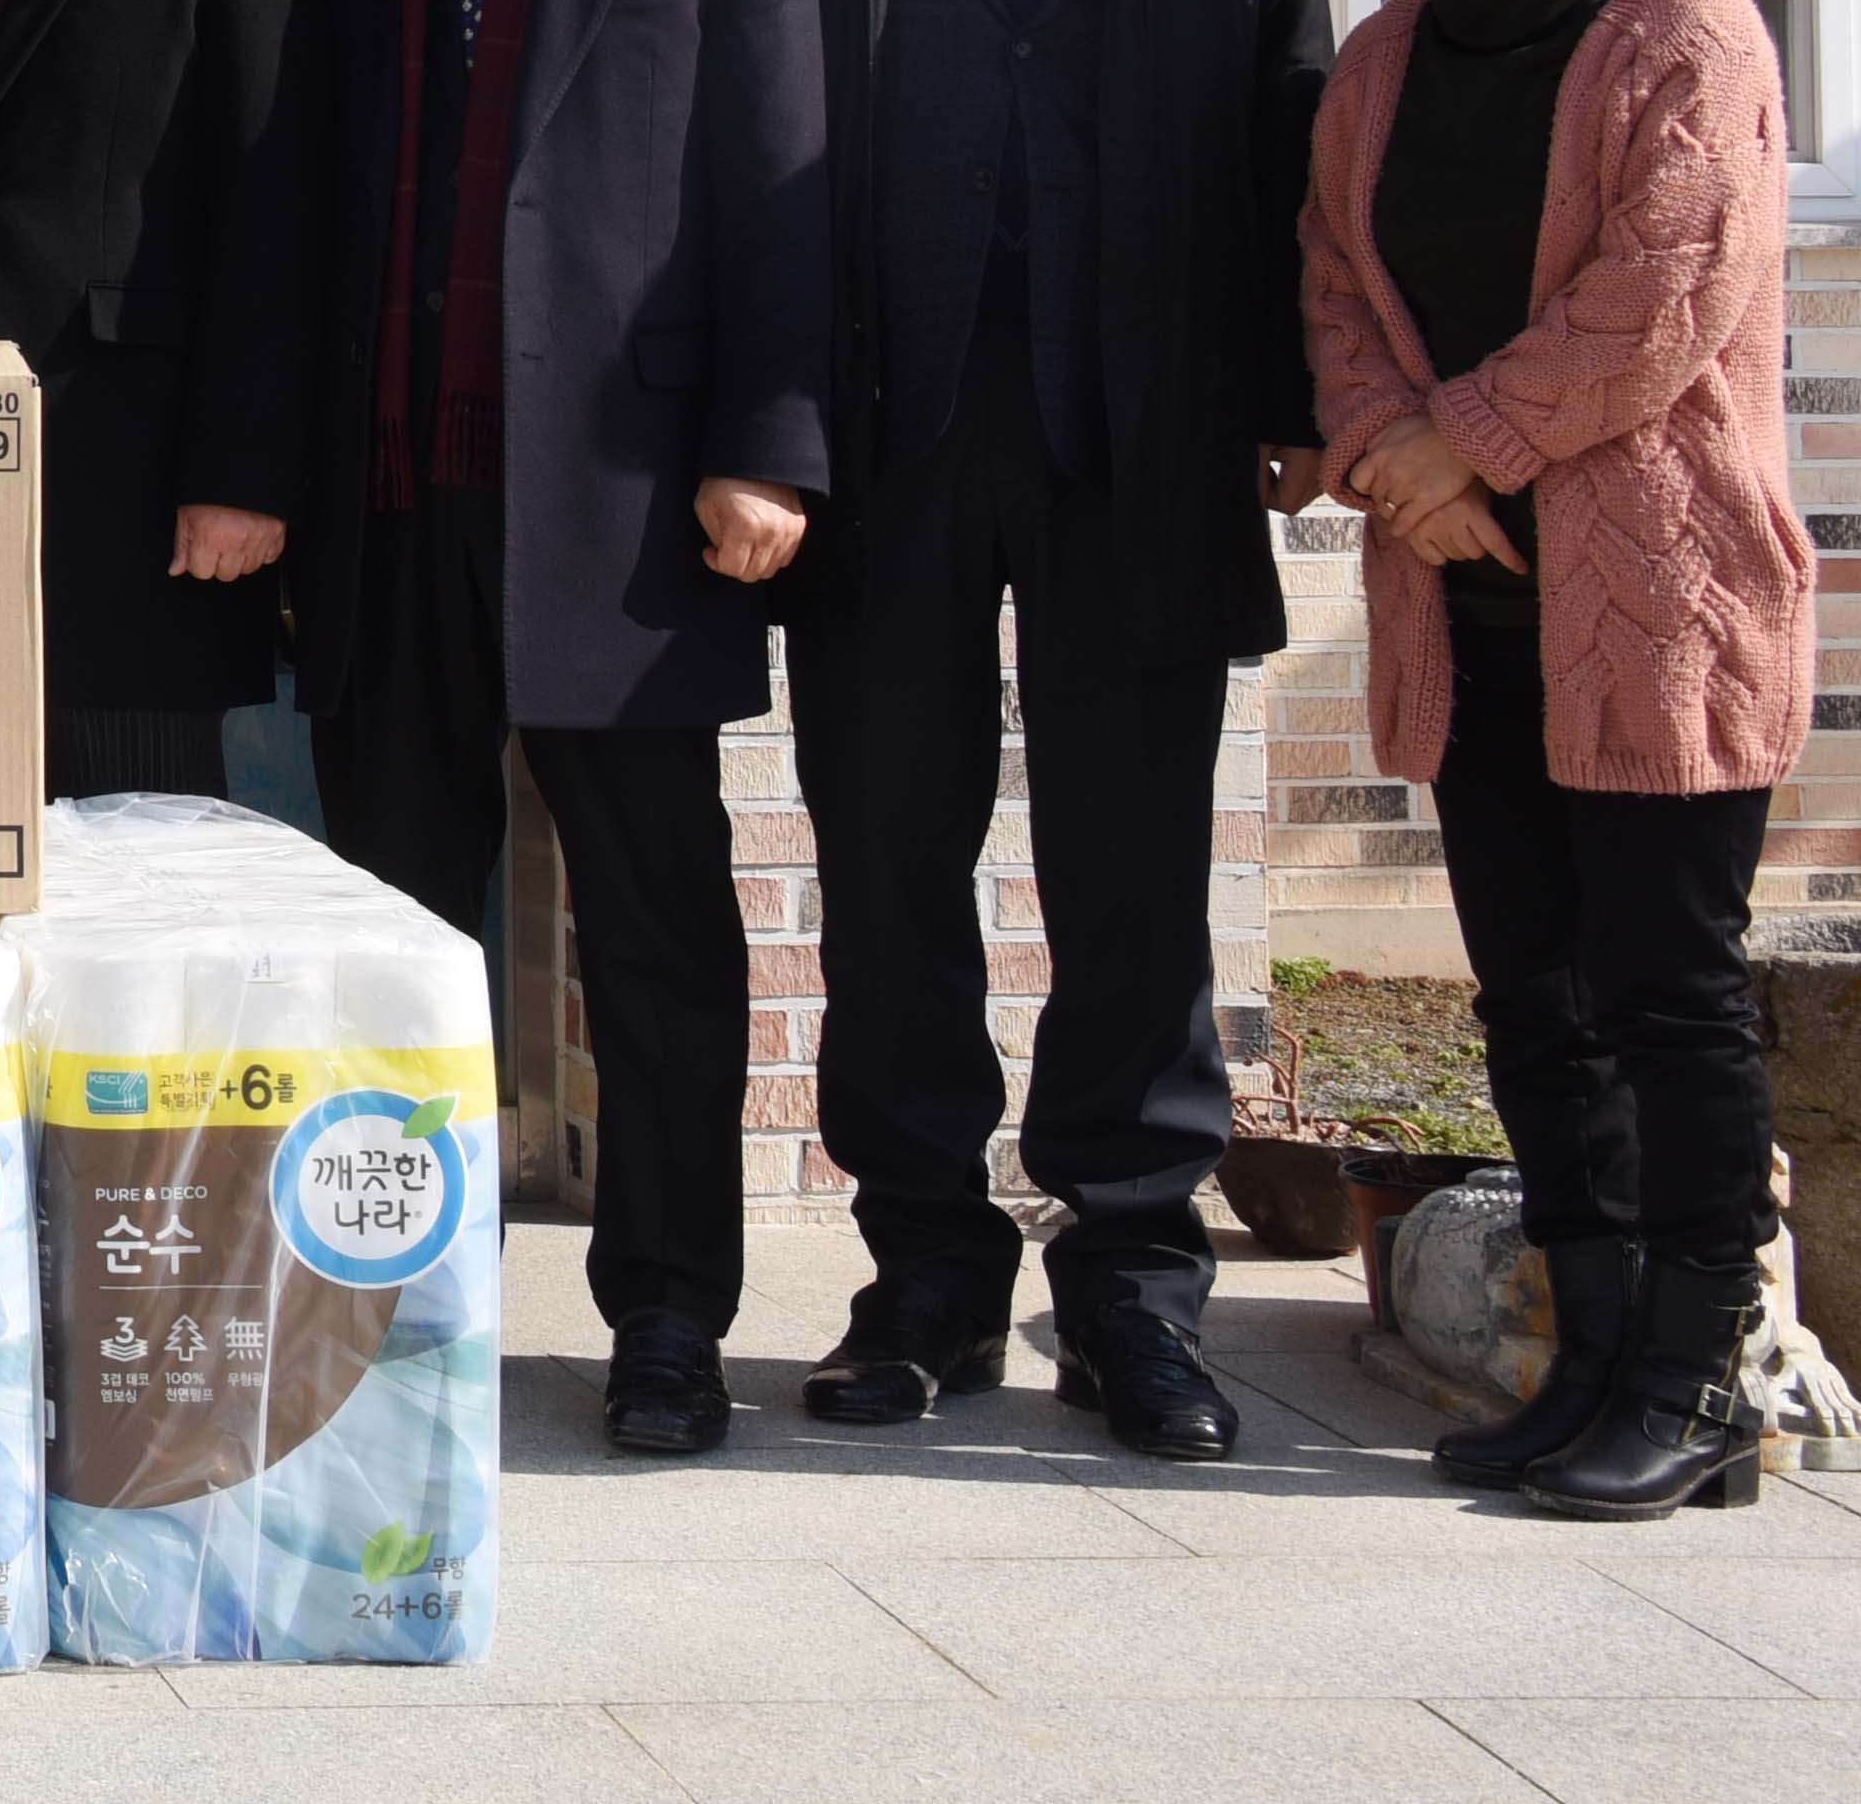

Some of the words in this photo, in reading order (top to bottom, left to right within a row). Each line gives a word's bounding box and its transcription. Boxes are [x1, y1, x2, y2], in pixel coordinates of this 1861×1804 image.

[313, 1151, 431, 1193] 깨끗한
[95, 1188, 139, 1201] PURE
[144, 1187, 155, 1201] &
[160, 1186, 207, 1200] DECO
[335, 1199, 411, 1236] 나라
[96, 1213, 201, 1275] 순수
[225, 1316, 264, 1360] 無
[165, 1372, 205, 1384] 100%
[430, 1556, 465, 1579] 무향
[351, 1589, 467, 1620] 24+6롤
